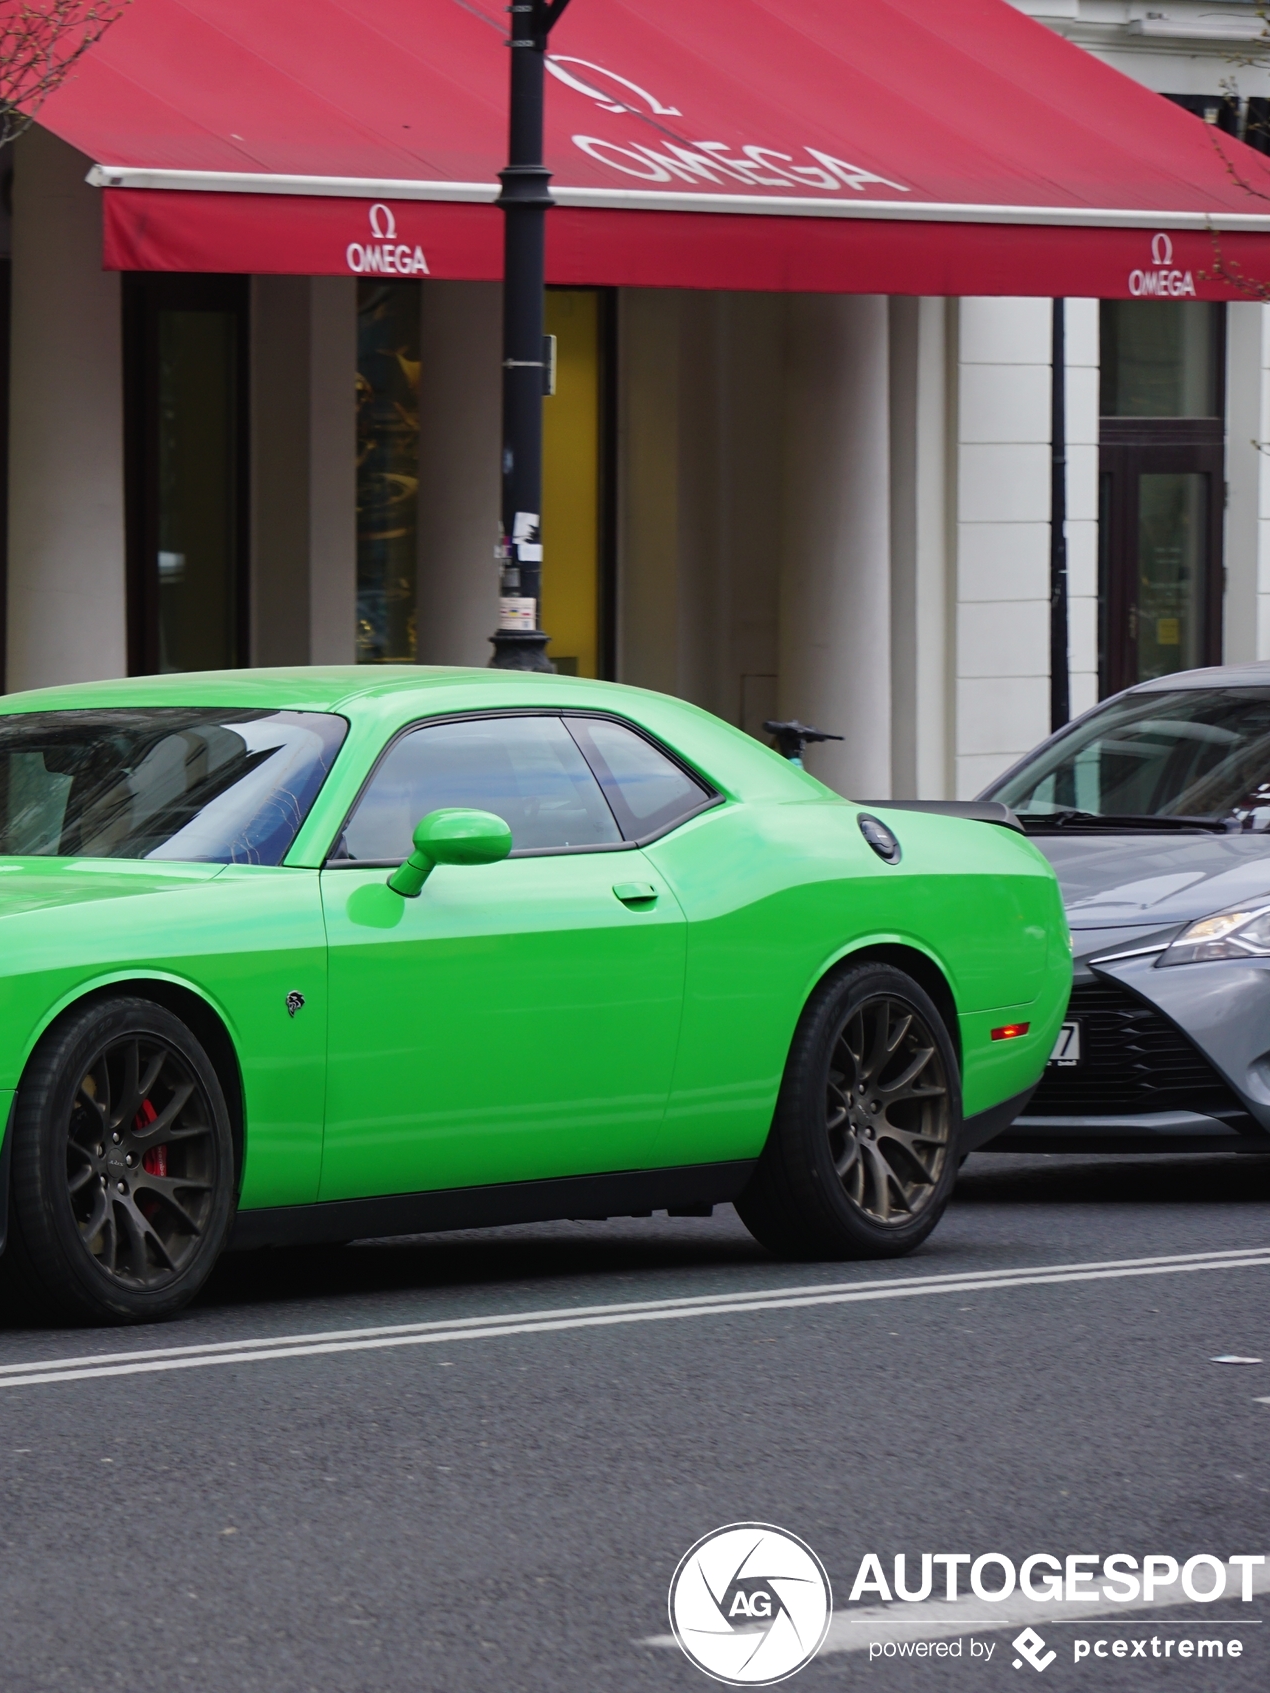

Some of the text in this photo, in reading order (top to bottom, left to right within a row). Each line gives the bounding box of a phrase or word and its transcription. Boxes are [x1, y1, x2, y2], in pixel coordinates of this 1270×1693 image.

[571, 134, 911, 192] OMEGA
[346, 242, 431, 275] OMEGA
[1128, 269, 1196, 297] OMEGA
